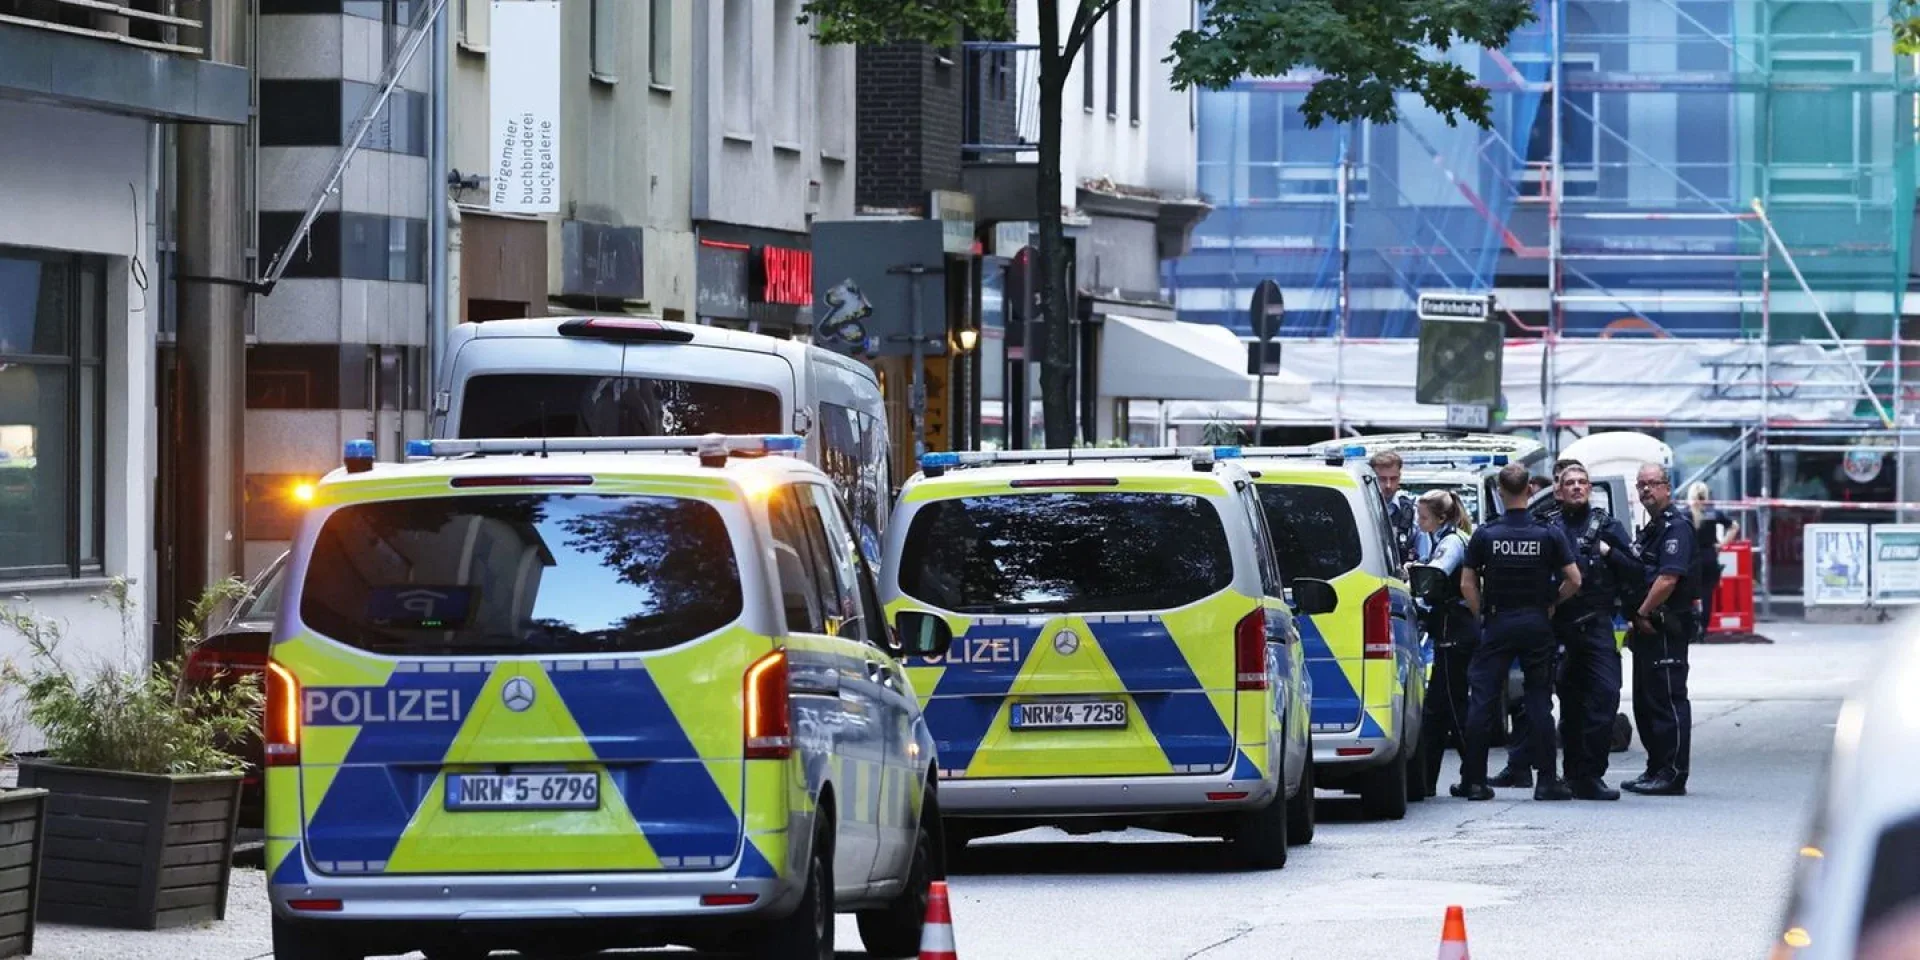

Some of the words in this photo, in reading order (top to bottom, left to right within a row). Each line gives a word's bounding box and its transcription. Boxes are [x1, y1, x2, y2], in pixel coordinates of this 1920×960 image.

[495, 119, 518, 204] mergemeier
[520, 113, 534, 204] buchbinderei
[538, 120, 554, 204] buchgalerie
[1492, 540, 1541, 556] POLIZEI
[902, 637, 1019, 664] LIZEI
[305, 688, 460, 722] POLIZEI
[1022, 706, 1054, 724] NRW
[1063, 704, 1124, 722] 4-7258
[460, 777, 503, 801] NRW
[516, 777, 595, 801] 5-6796
